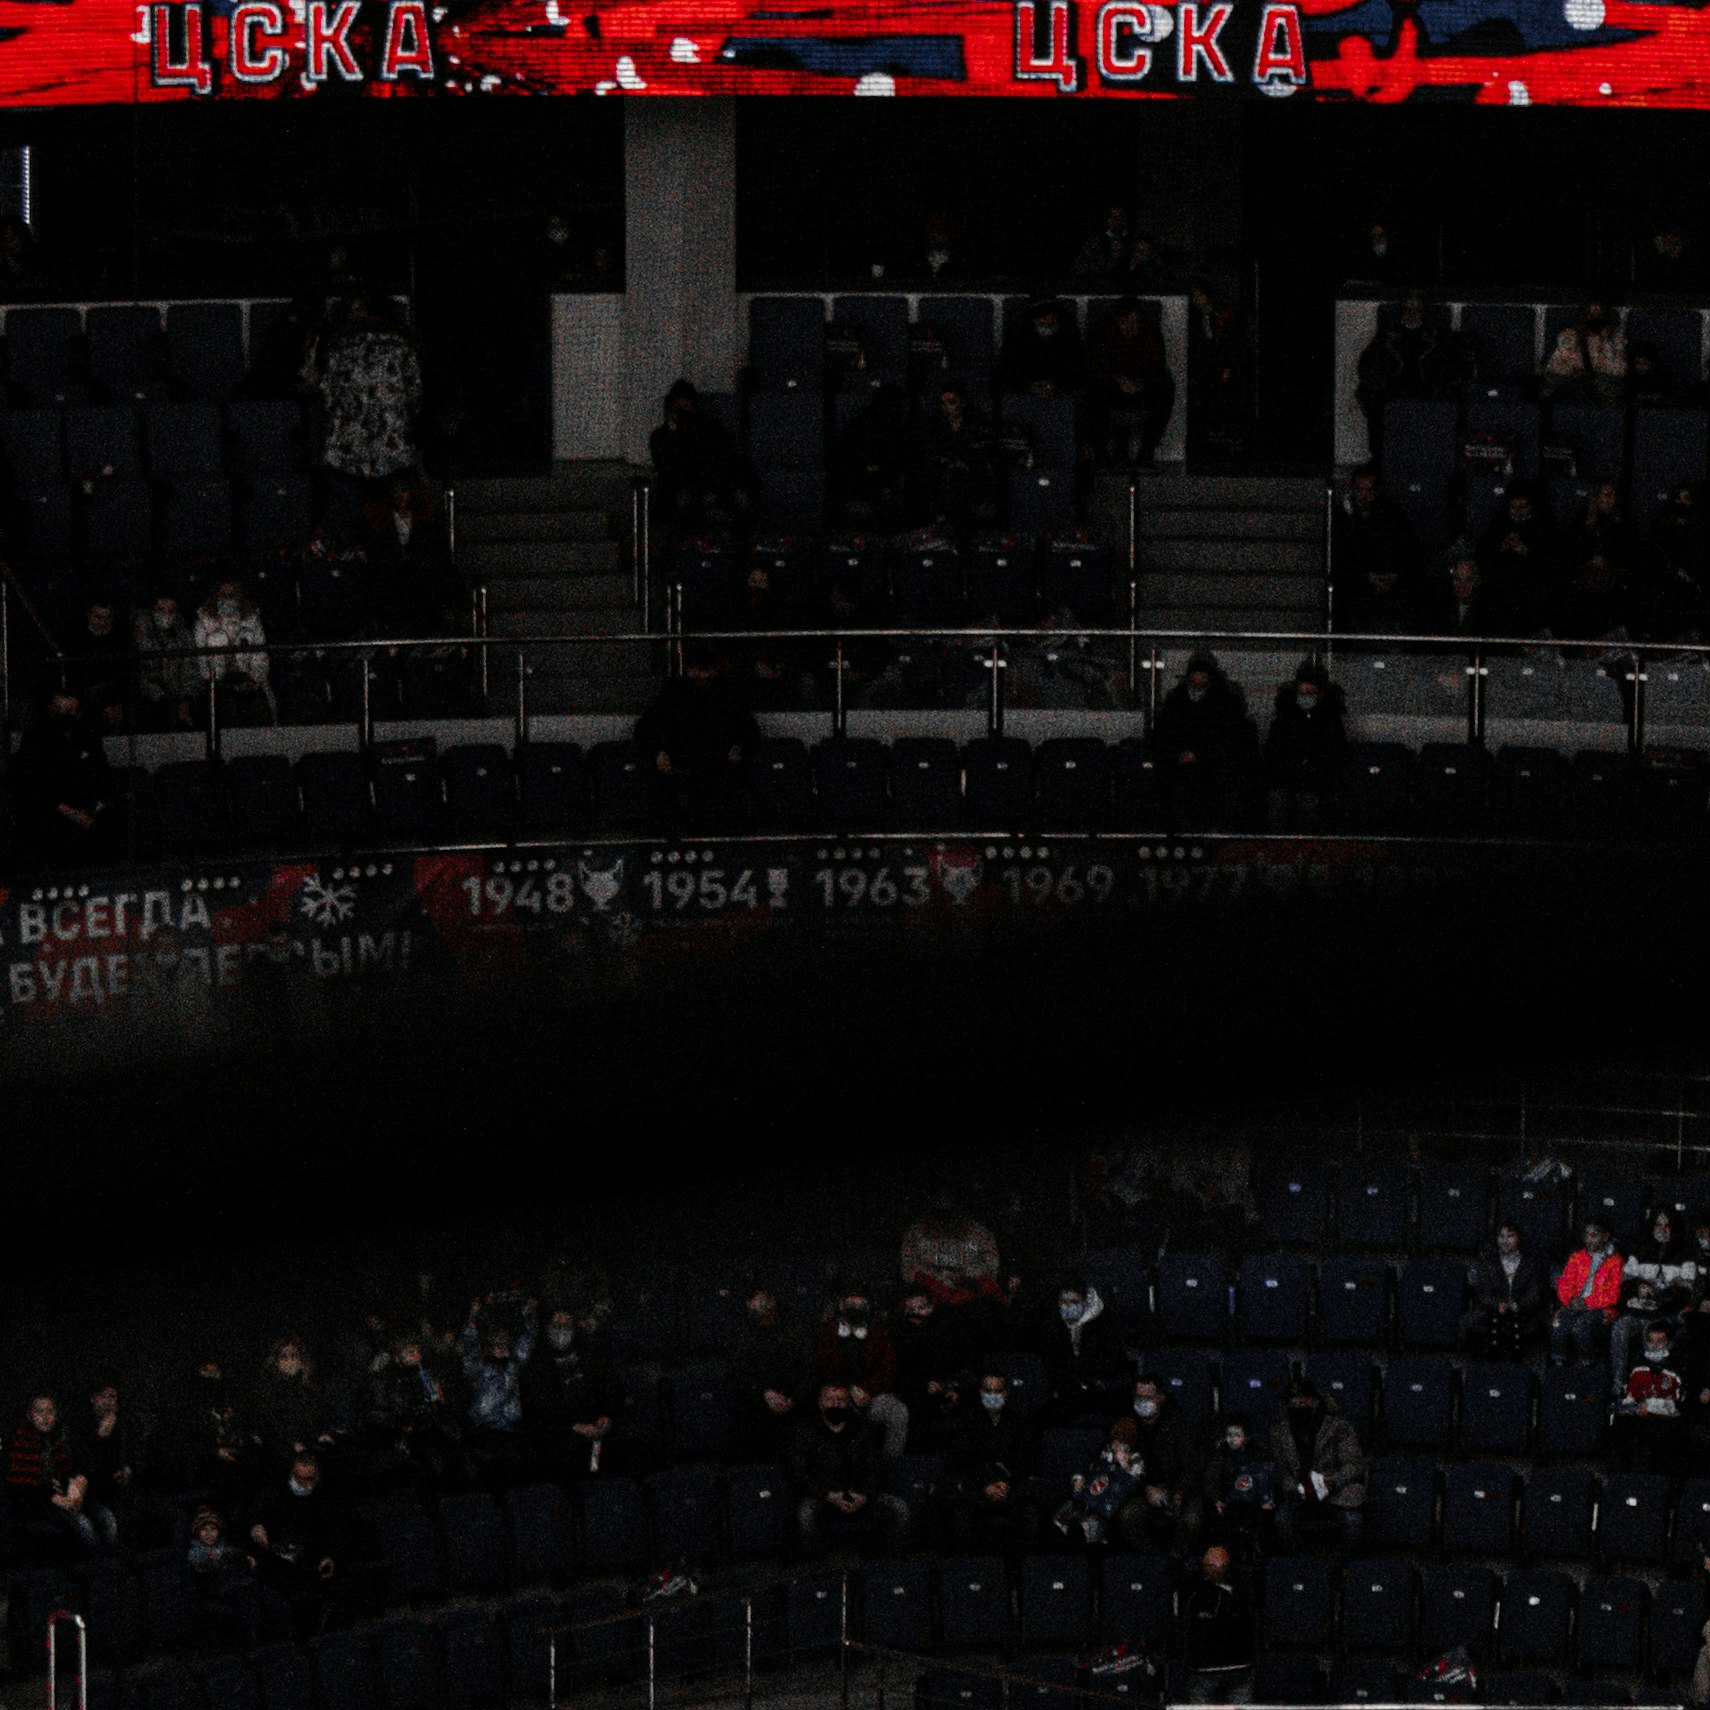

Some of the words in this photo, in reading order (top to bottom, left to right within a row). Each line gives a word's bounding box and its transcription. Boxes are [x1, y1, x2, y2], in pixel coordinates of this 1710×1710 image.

[150, 0, 437, 94] ЦСКА
[1016, 1, 1306, 92] ЦСКА
[19, 889, 211, 945] ВСЕГДА
[461, 872, 574, 915] 1948
[643, 868, 757, 909] 1954
[815, 866, 930, 908] 1963
[1002, 864, 1114, 905] 1969
[8, 952, 145, 1004] БУДЕ
